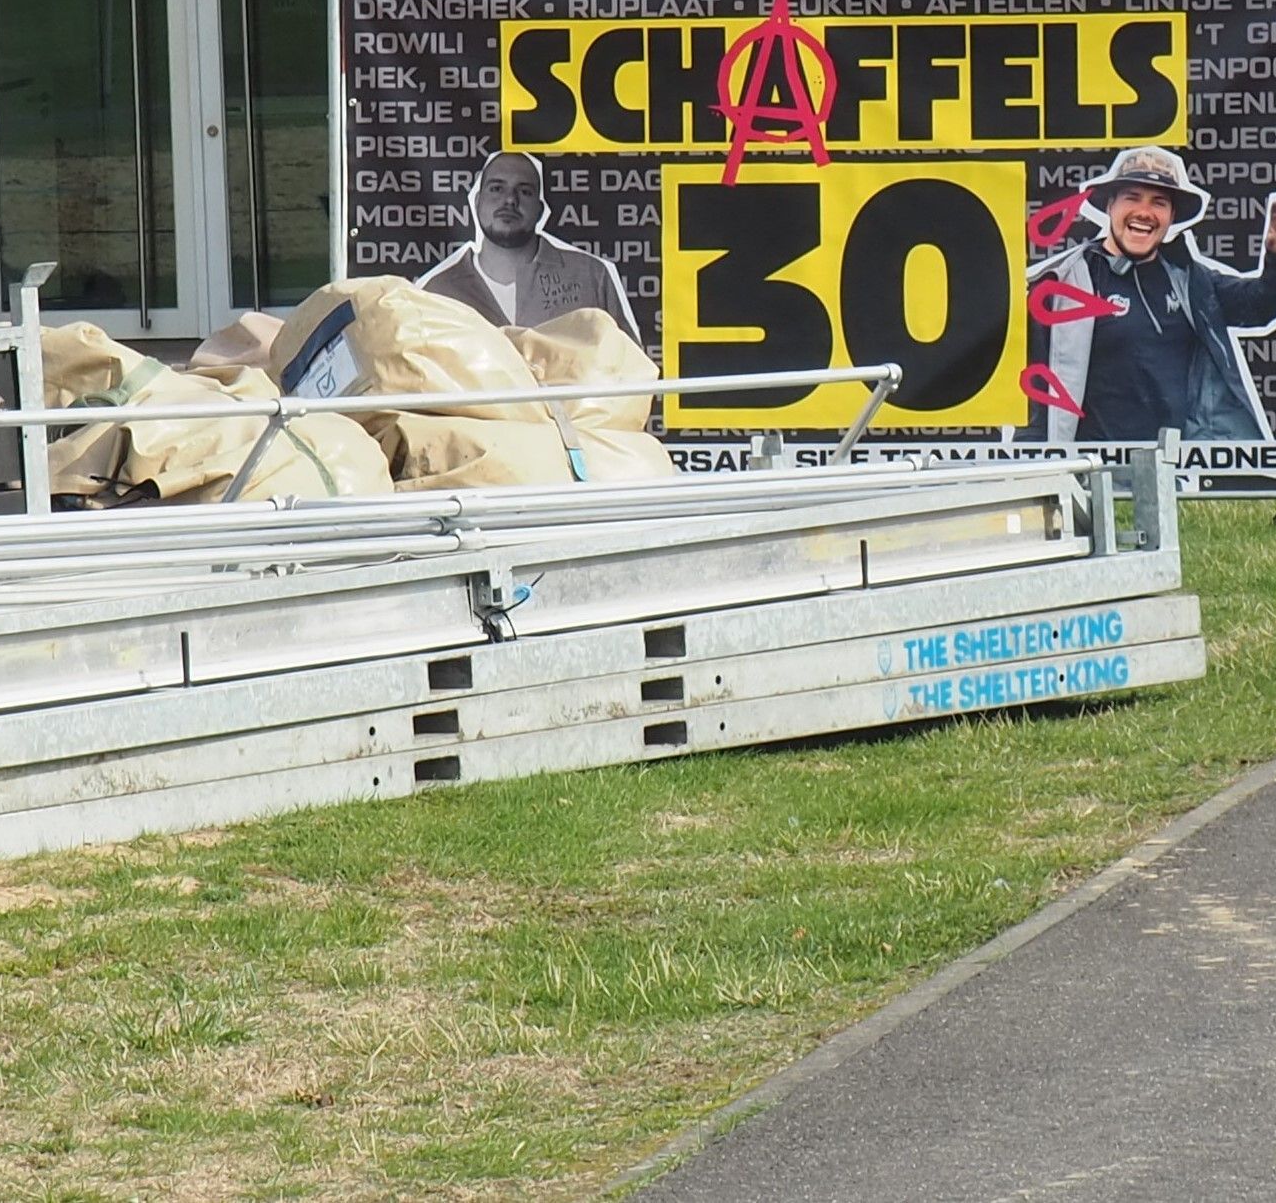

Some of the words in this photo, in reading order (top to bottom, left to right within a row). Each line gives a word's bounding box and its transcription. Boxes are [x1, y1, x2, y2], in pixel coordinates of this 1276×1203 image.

[354, 32, 464, 55] ROWILI
[354, 66, 427, 93] HEK,
[509, 20, 1179, 144] SCHAFFELS
[355, 135, 491, 158] PISBLOK
[355, 170, 422, 193] GAS
[355, 204, 469, 227] MOGEN
[677, 177, 1012, 411] 30
[904, 636, 948, 671] THE
[954, 621, 1053, 664] SHELTER
[1061, 609, 1123, 648] KING
[909, 681, 953, 712] THE
[959, 666, 1059, 710] SHELTER
[1066, 654, 1129, 694] KING
